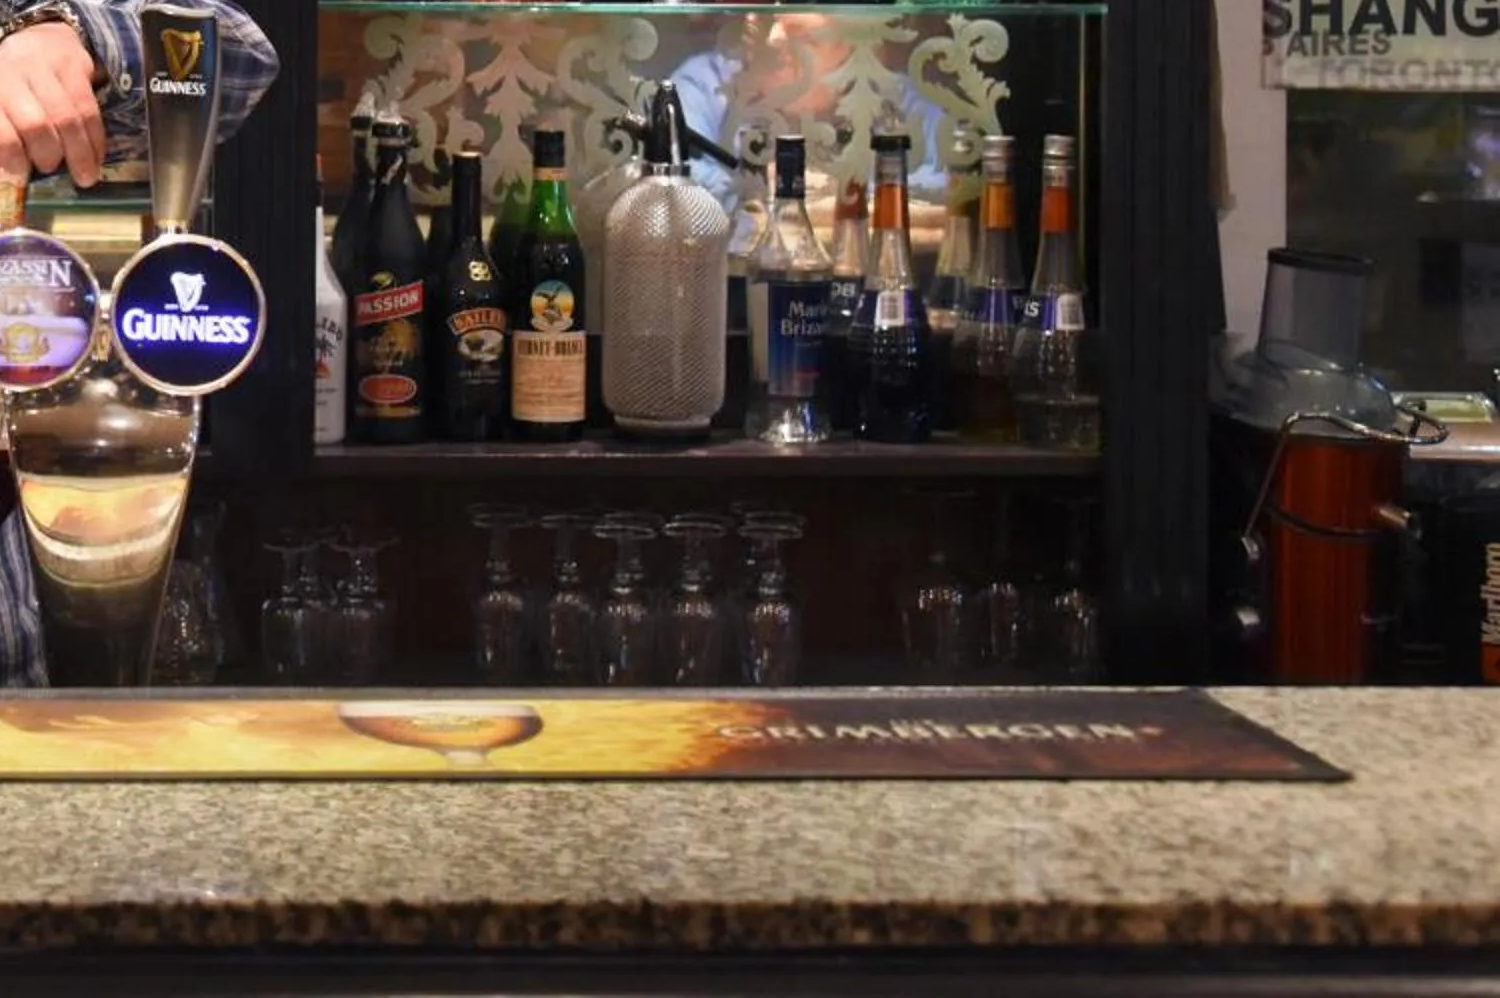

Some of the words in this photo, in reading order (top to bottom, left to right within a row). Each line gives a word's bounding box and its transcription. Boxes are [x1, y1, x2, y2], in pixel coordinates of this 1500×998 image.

[1287, 29, 1390, 57] AIRES
[150, 77, 207, 96] GUINNESS
[122, 308, 251, 345] GUINNESS
